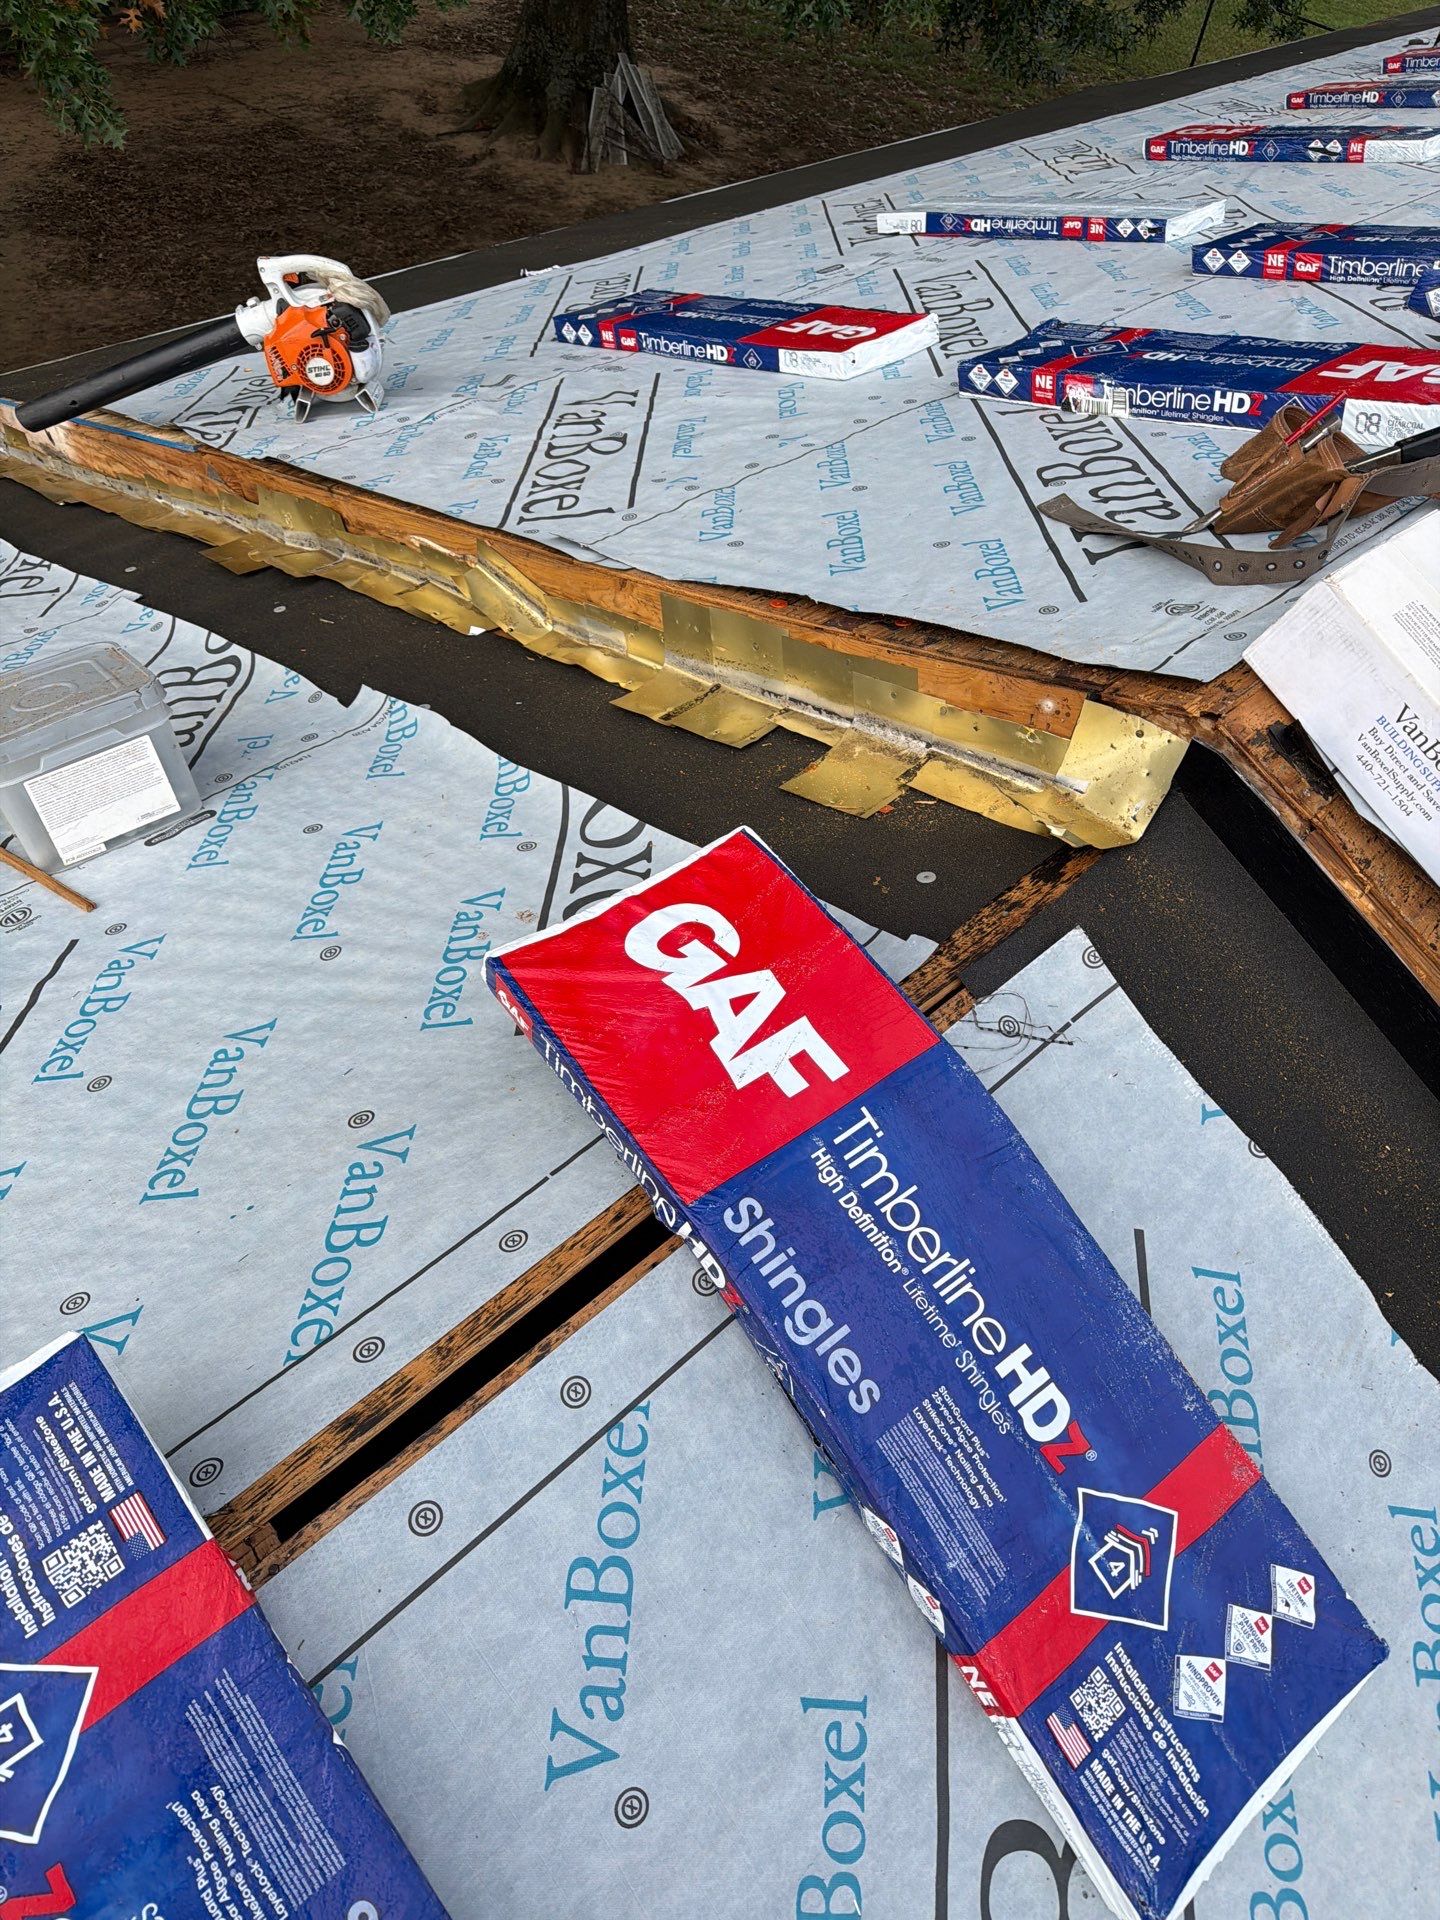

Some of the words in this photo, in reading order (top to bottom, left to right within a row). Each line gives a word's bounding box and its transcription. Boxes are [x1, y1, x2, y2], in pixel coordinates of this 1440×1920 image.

[1291, 96, 1304, 104] GAF
[1150, 145, 1167, 153] GAF
[1350, 142, 1363, 153] NE
[1064, 221, 1082, 229] GAF
[1089, 224, 1104, 234] NE
[1267, 253, 1285, 267] NE
[1296, 262, 1320, 274] GAF
[602, 329, 614, 342] NE
[621, 336, 636, 347] GAF
[775, 320, 877, 340] GAF
[1035, 374, 1053, 390] NE
[1192, 411, 1224, 423] Shingles
[517, 389, 639, 526] VanBoxel
[935, 460, 987, 517] VanBoxel
[821, 509, 867, 577] VanBoxel
[963, 537, 1028, 612] VanBoxel
[1376, 715, 1424, 768] BUILDING
[1357, 733, 1432, 821] VanBoxelSupply.com
[1368, 726, 1385, 746] Buy
[1384, 744, 1409, 774] Direct
[1407, 774, 1426, 791] and
[1422, 789, 1440, 812] Save
[291, 820, 384, 943] VanBoxel
[420, 887, 507, 1032] VanBoxel
[32, 932, 168, 1085] VanBoxel
[498, 990, 530, 1032] GAF
[624, 902, 851, 1099] GAF
[139, 1017, 279, 1206] VanBoxel
[723, 1196, 881, 1415] Shingles
[810, 1147, 845, 1194] High
[955, 1350, 1012, 1435] Shingles
[48, 1391, 74, 1431] U.S.A.
[61, 1387, 81, 1416] MATERIALS.
[69, 1381, 90, 1411] FACTORIES.
[938, 1385, 974, 1436] StainGuard
[5, 1417, 20, 1437] enlace.
[77, 1414, 96, 1442] IMPORTED
[86, 1409, 106, 1437] AMERICAN
[931, 1391, 955, 1425] 25-year
[953, 1426, 973, 1453] Algae
[66, 1427, 88, 1454] THE
[106, 1443, 118, 1458] JOBS
[36, 1416, 97, 1514] gaf.com/StrikeZone
[80, 1451, 97, 1468] IN
[99, 1451, 118, 1479] DOMESTIC
[114, 1457, 134, 1486] AMERICAN
[32, 1480, 48, 1503] código
[42, 1476, 55, 1496] recibir
[89, 1465, 116, 1503] MADE
[113, 1477, 125, 1493] WITH
[945, 1454, 981, 1509] Technology
[955, 1449, 978, 1484] Nailing
[976, 1484, 994, 1507] Area
[0, 1515, 14, 1535] de
[19, 1504, 32, 1523] Code
[48, 1508, 63, 1537] Escanee
[58, 1510, 70, 1530] 41595
[34, 1532, 45, 1550] Scan
[39, 1520, 53, 1544] receive
[7, 1534, 56, 1627] Instrucciones
[1107, 1559, 1126, 1578] 4
[0, 1559, 38, 1639] Installation
[1239, 1620, 1253, 1640] PLUS
[1239, 1612, 1268, 1653] STAINGUARD
[959, 1664, 1000, 1709] NE
[1114, 1642, 1154, 1709] Installation
[1153, 1707, 1200, 1783] instructions
[1104, 1651, 1154, 1730] Instrucciones
[1152, 1730, 1167, 1749] de
[1166, 1748, 1209, 1817] instalación
[191, 1790, 212, 1820] Area
[1090, 1759, 1115, 1796] MADE
[1111, 1794, 1125, 1810] IN
[1122, 1808, 1142, 1835] THE
[210, 1785, 252, 1858] Technology
[1079, 1775, 1099, 1804] AMERICAN
[1110, 1824, 1133, 1854] AMERICAN
[209, 1818, 236, 1867] Nailing
[210, 1861, 231, 1903] Algae
